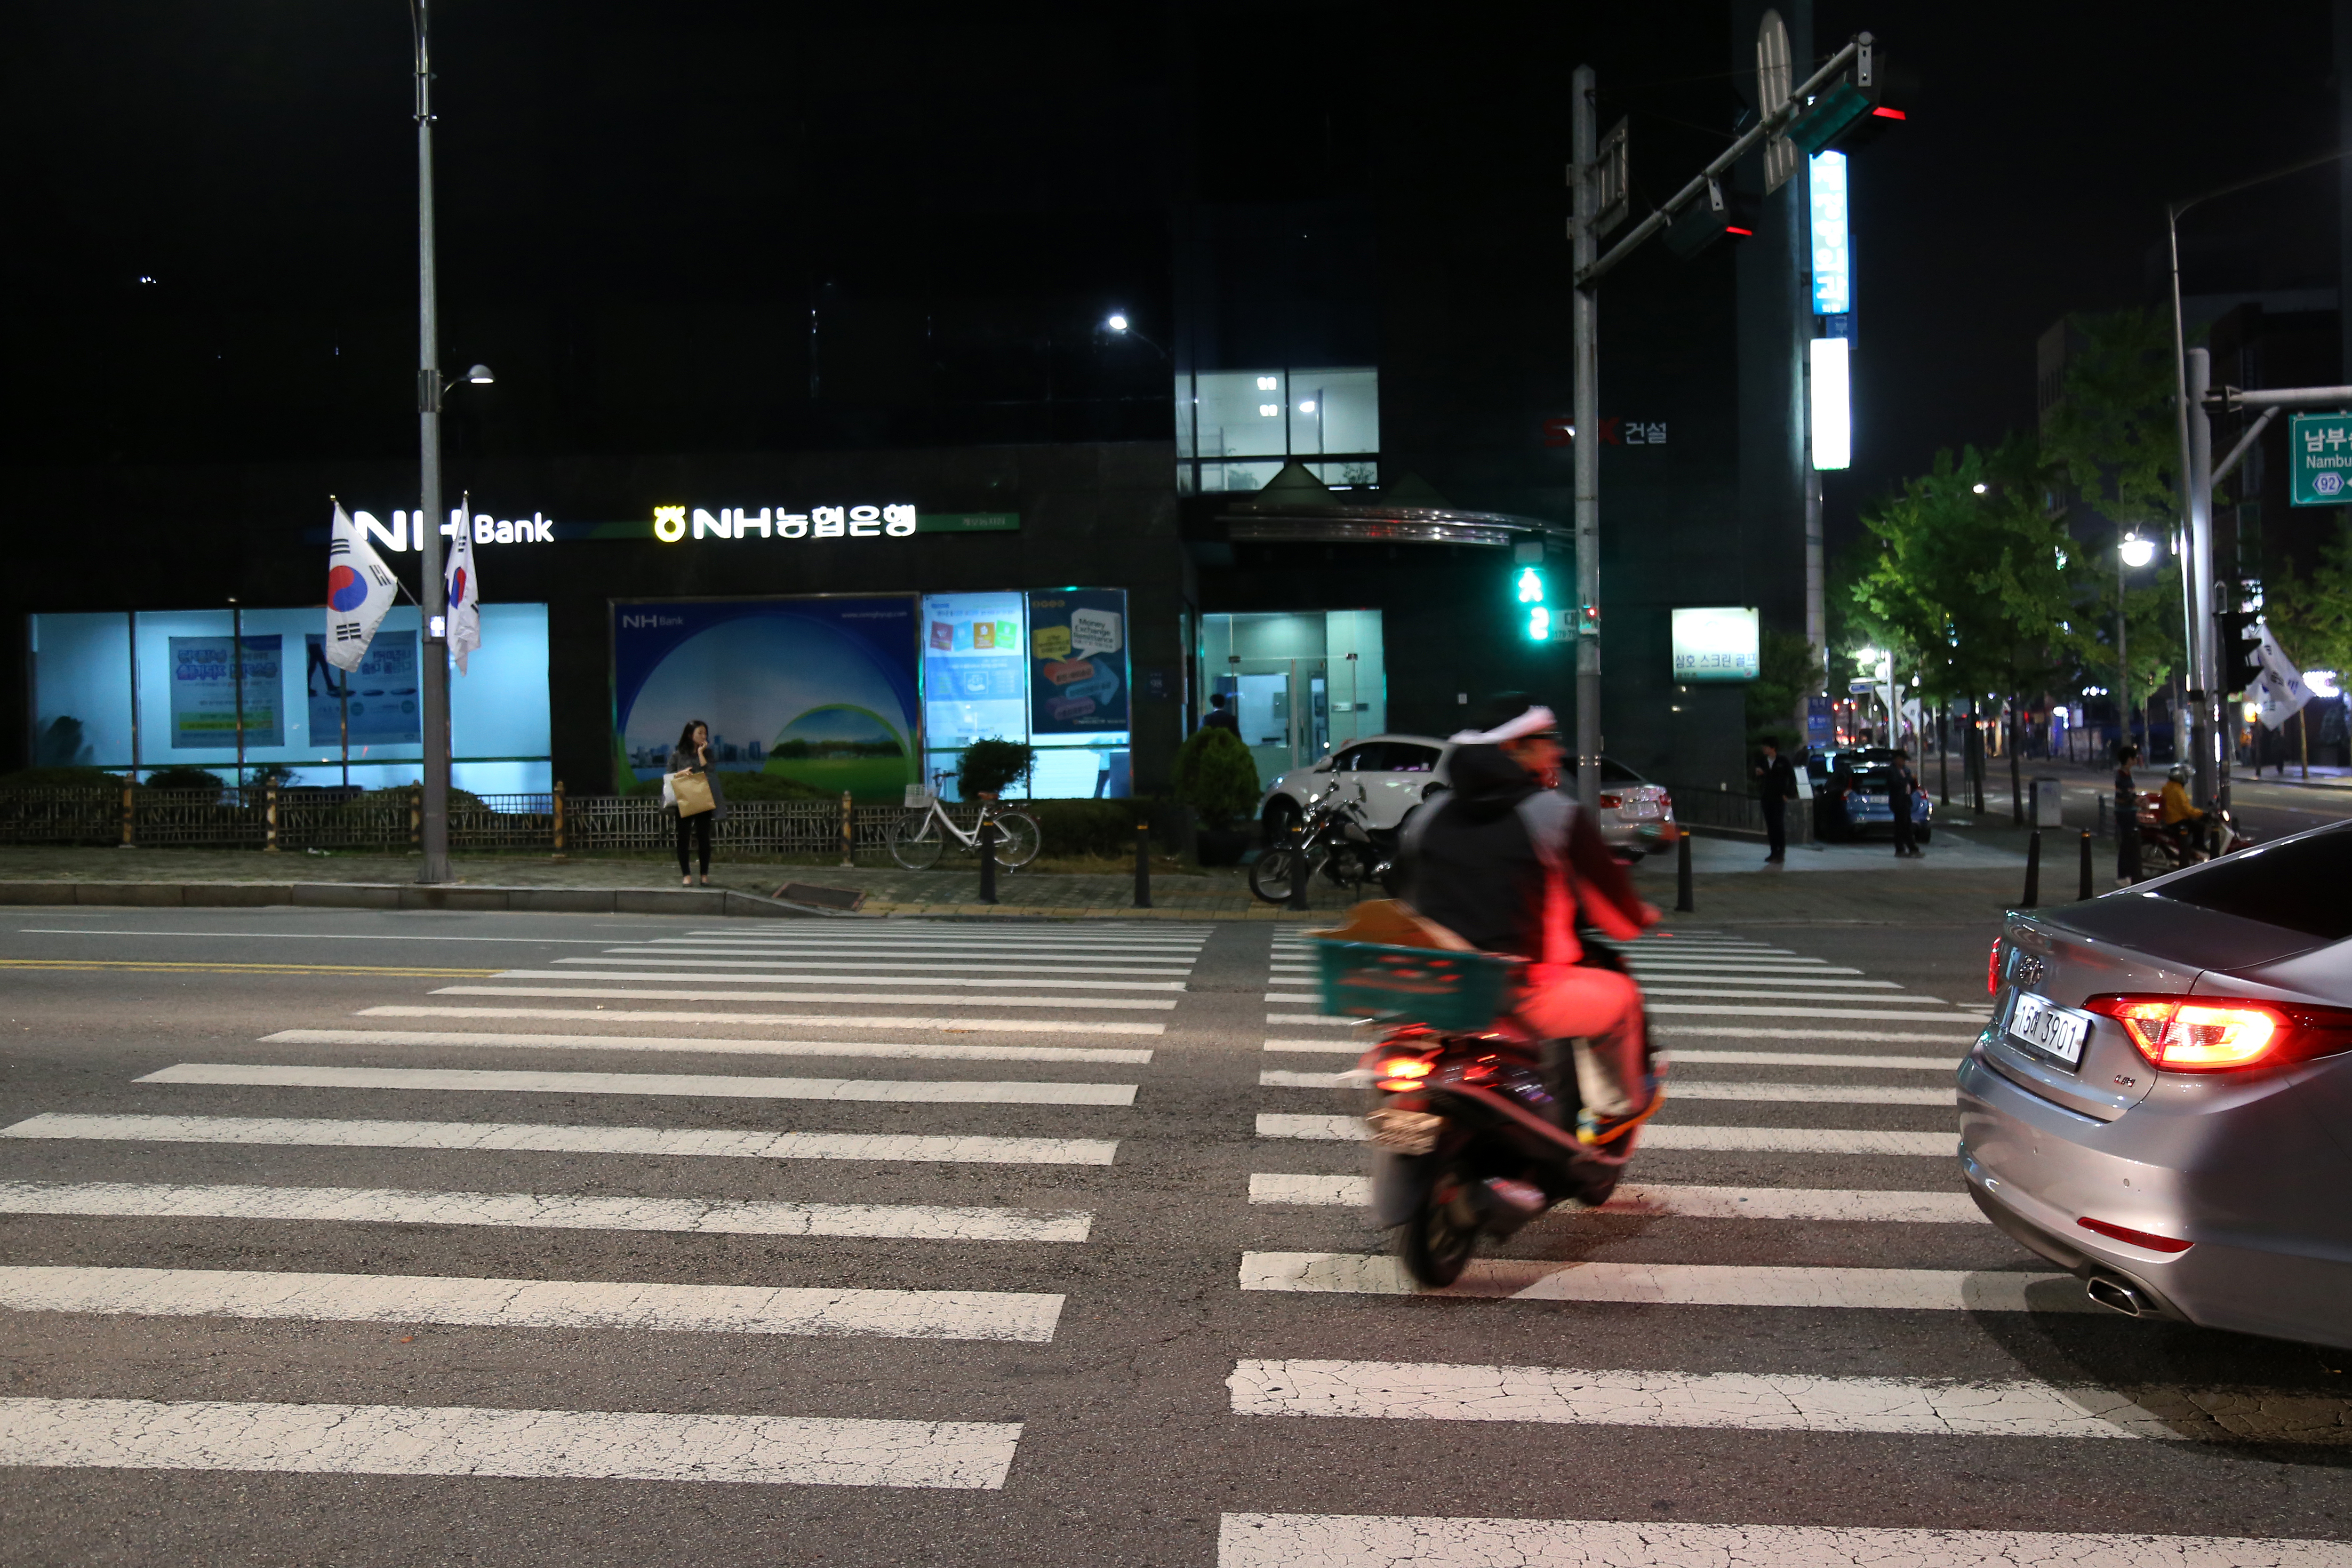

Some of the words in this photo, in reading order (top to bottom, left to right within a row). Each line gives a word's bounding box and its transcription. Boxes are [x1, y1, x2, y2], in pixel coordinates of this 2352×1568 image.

[1543, 417, 1620, 447] SX
[1625, 422, 1666, 445] 건설
[2304, 428, 2352, 453] 남부
[2306, 455, 2352, 469] Nambu
[2321, 477, 2336, 491] 92
[474, 512, 555, 544] Bank
[693, 504, 916, 539] NH농협은행
[623, 615, 657, 628] NH
[659, 616, 683, 626] Bank
[1075, 625, 1111, 637] Exchange
[1079, 618, 1105, 630] Money
[1530, 606, 1549, 640] 2
[1700, 654, 1731, 667] 스크린
[1736, 653, 1756, 667] 골프
[2041, 1012, 2077, 1055] 3901
